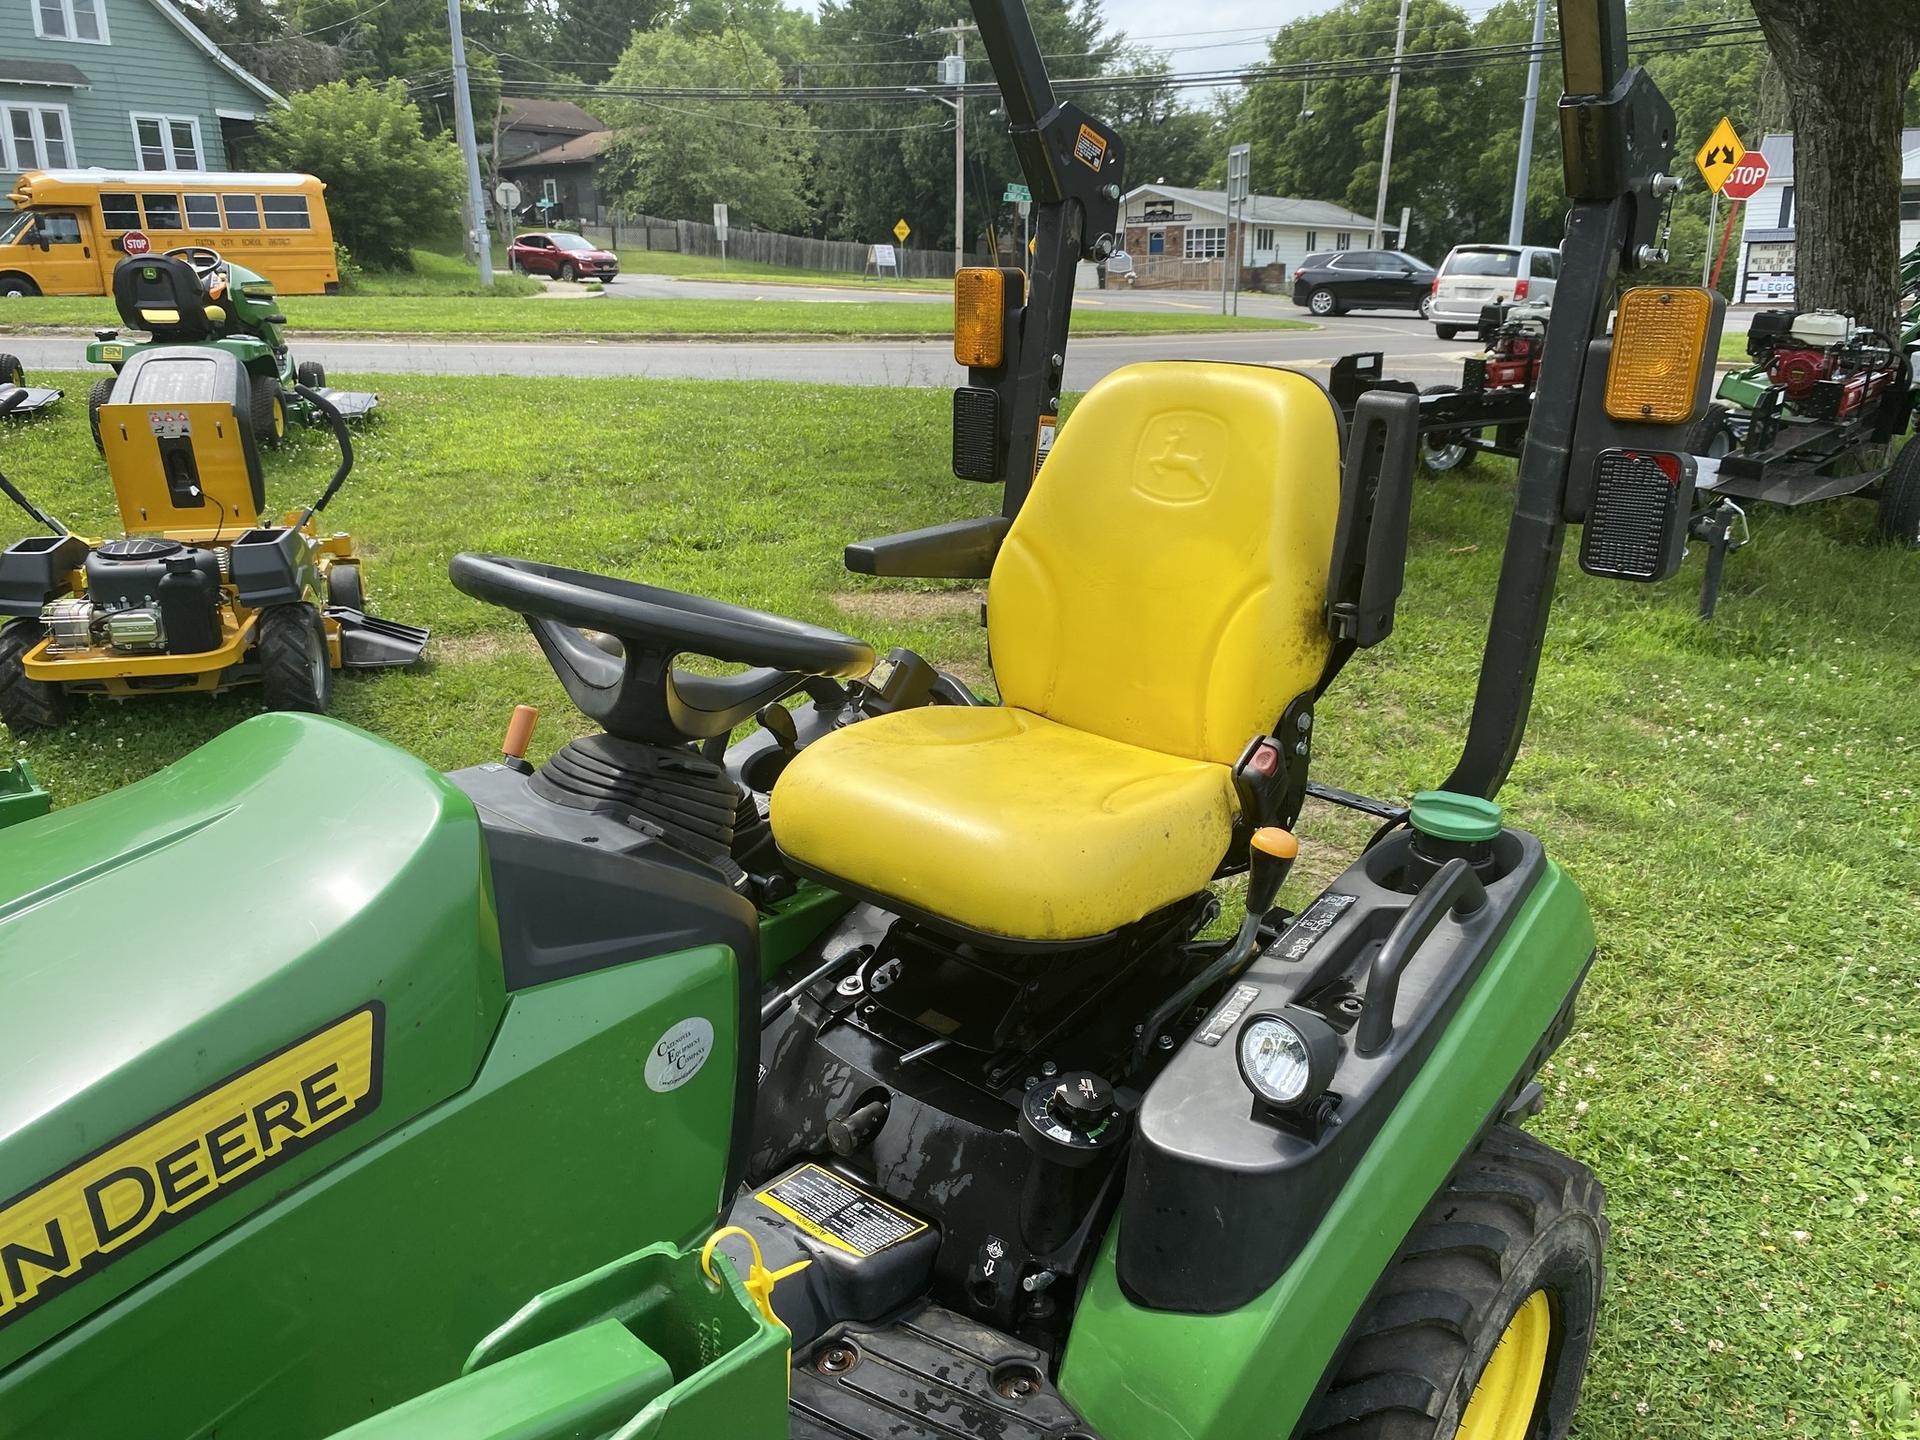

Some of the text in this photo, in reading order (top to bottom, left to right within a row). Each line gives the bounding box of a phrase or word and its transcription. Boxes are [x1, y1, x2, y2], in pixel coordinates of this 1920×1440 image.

[127, 239, 147, 249] STOP
[1760, 283, 1794, 291] LEGIO
[83, 1061, 348, 1248] DEERE
[796, 1214, 822, 1233] CAUTION
